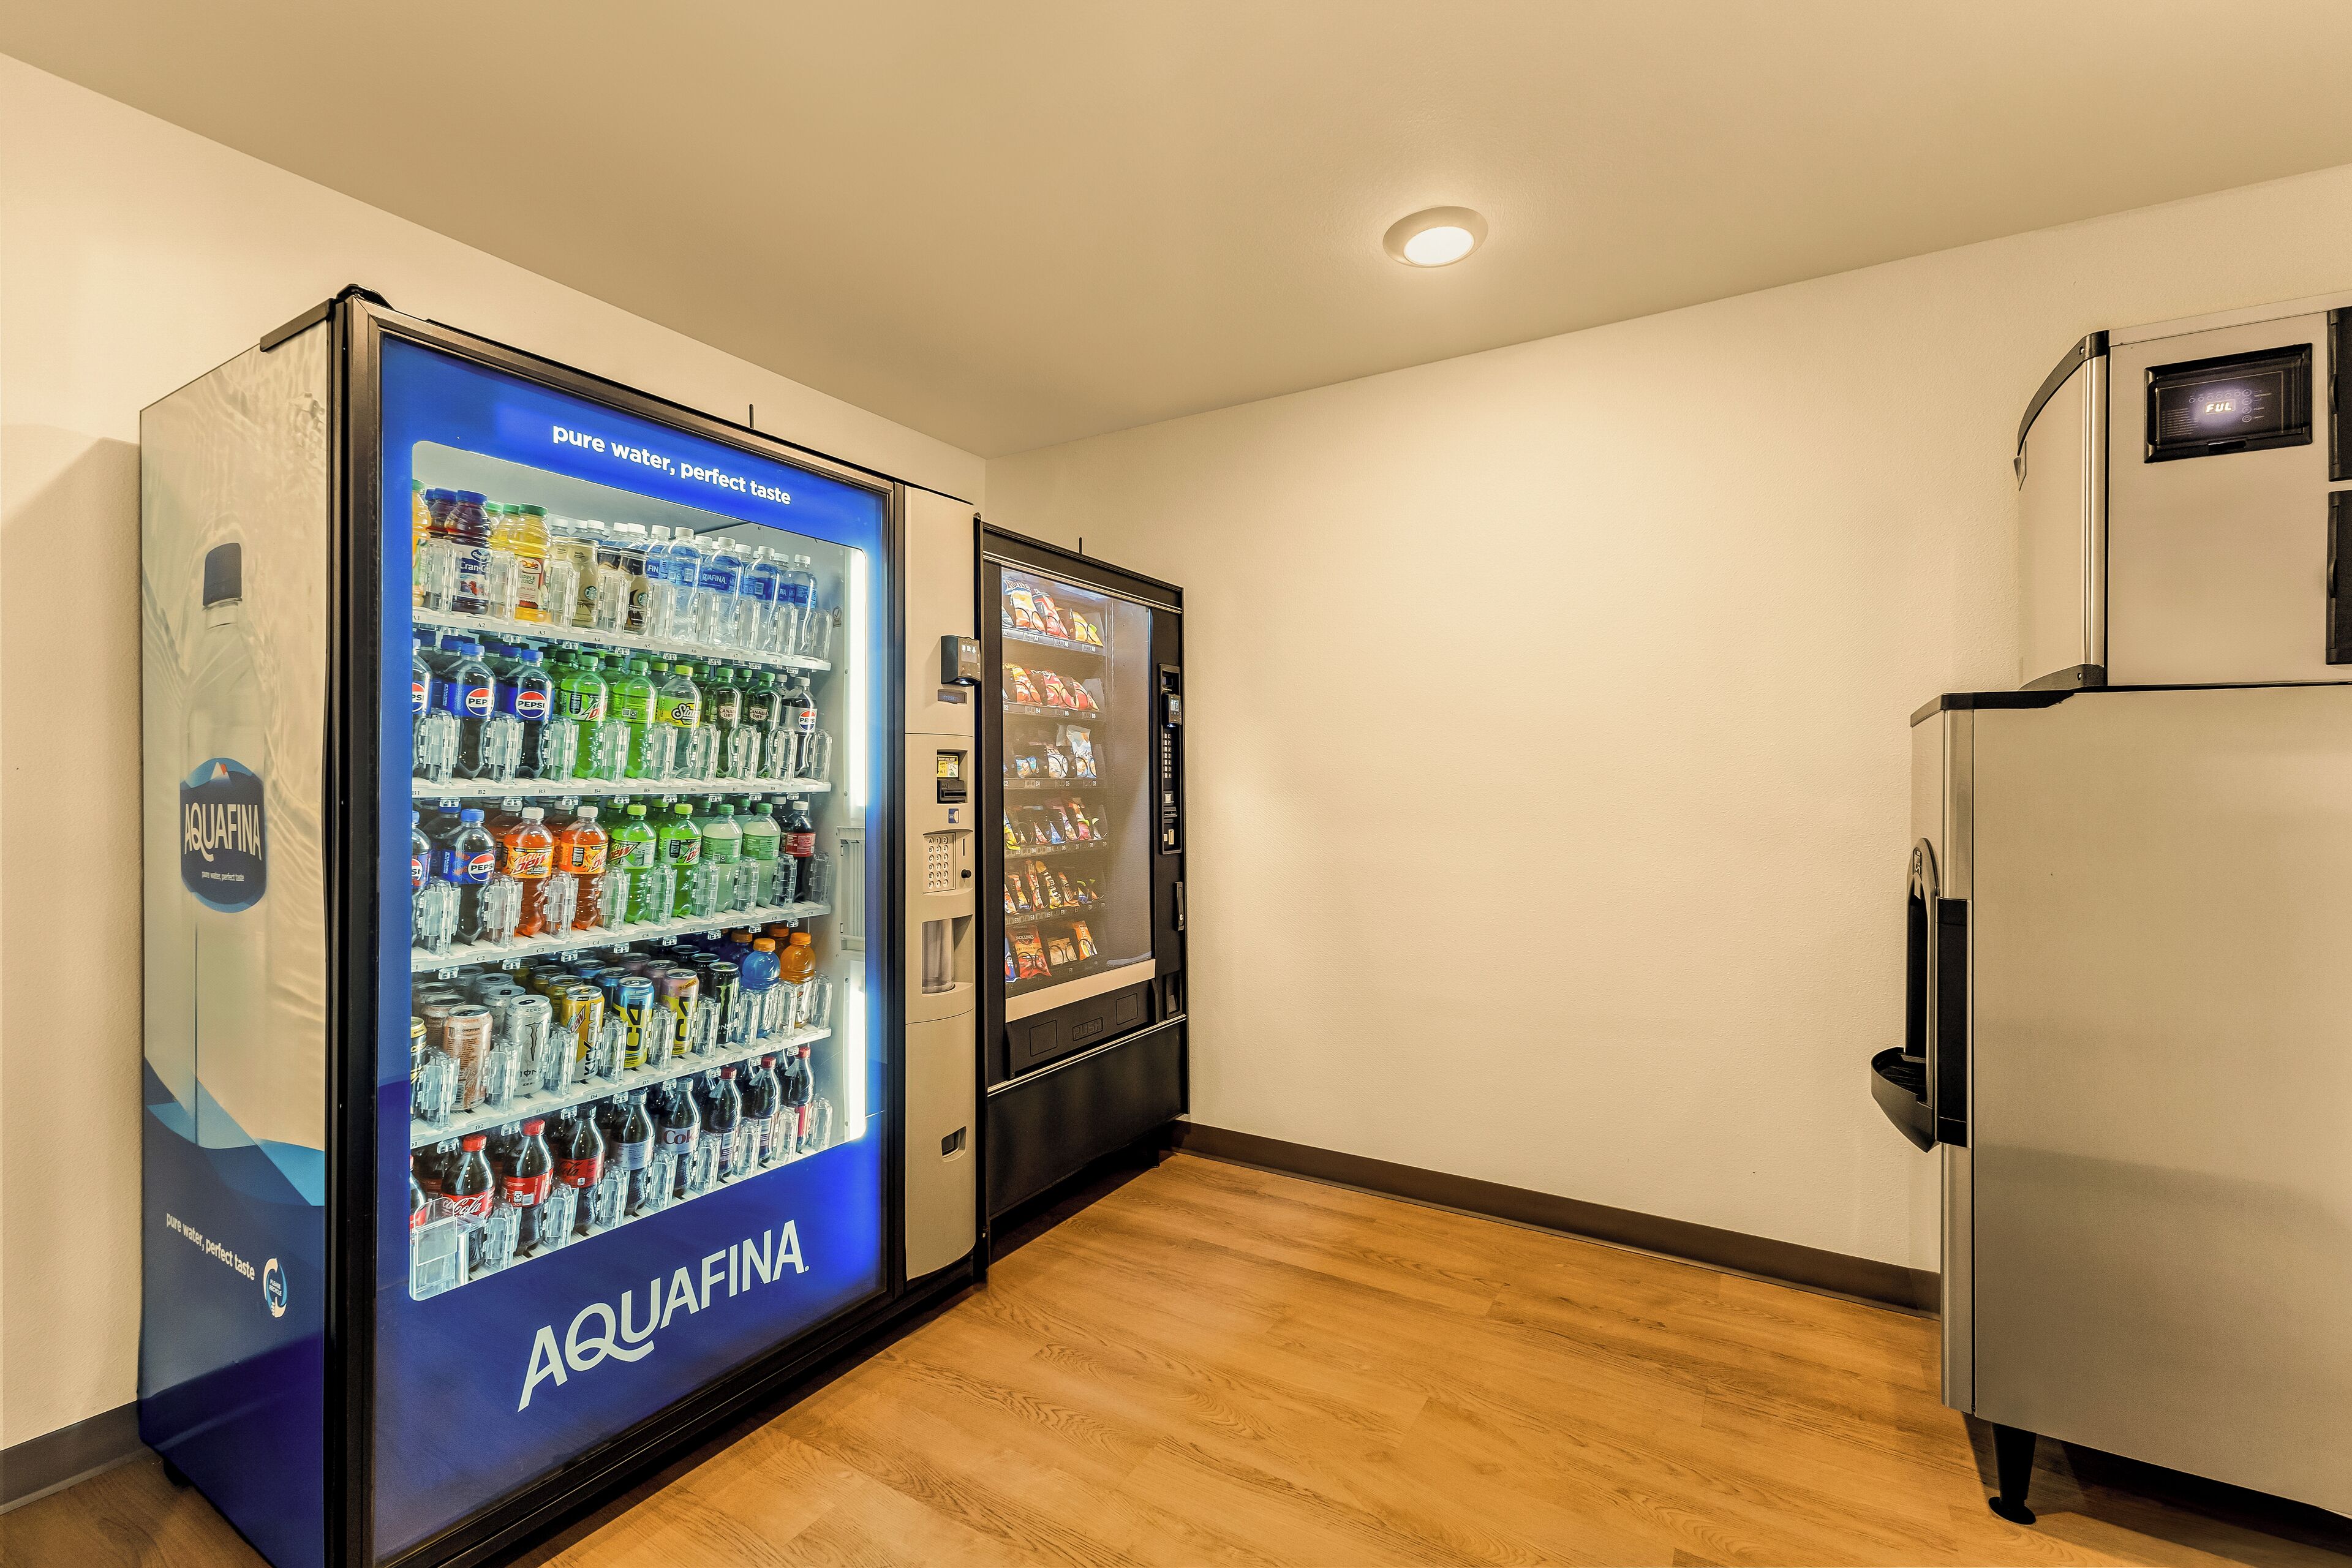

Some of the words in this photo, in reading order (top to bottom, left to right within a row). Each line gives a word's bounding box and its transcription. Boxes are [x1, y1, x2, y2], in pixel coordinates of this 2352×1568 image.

[2206, 402, 2232, 413] FUL
[552, 425, 606, 453] pure
[611, 442, 676, 476] water,
[680, 461, 747, 492] perfect
[750, 480, 791, 505] taste
[703, 573, 727, 584] QUAFINA
[184, 802, 262, 862] AQUAFINA
[1073, 1019, 1102, 1040] PUSH
[663, 1129, 695, 1145] Cok
[167, 1213, 181, 1233] pure
[183, 1223, 205, 1251] water,
[206, 1238, 233, 1267] perfect
[235, 1254, 255, 1281] taste
[518, 1219, 805, 1412] AQUAFINA
